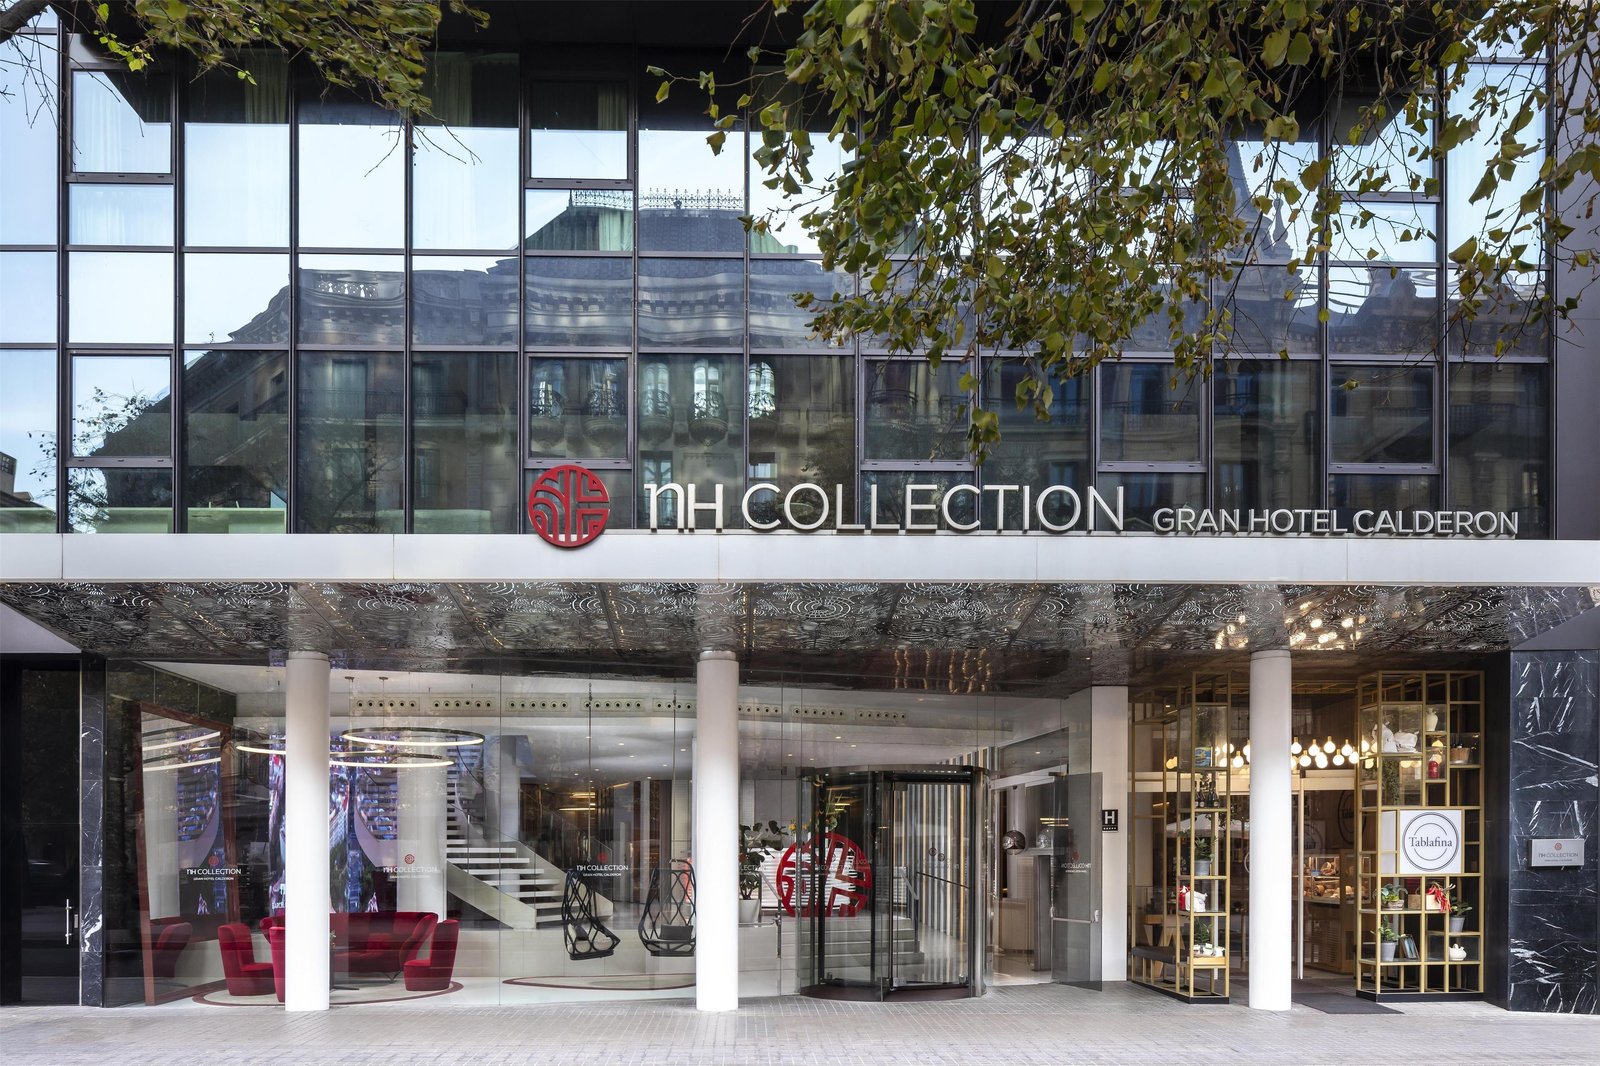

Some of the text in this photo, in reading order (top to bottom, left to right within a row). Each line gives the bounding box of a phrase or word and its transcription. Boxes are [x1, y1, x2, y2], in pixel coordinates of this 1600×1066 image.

[741, 483, 1125, 533] COLLECTION
[1153, 508, 1519, 535] GRAN HOTEL CALDERON
[1104, 811, 1115, 824] H
[1408, 836, 1453, 847] Tablafina
